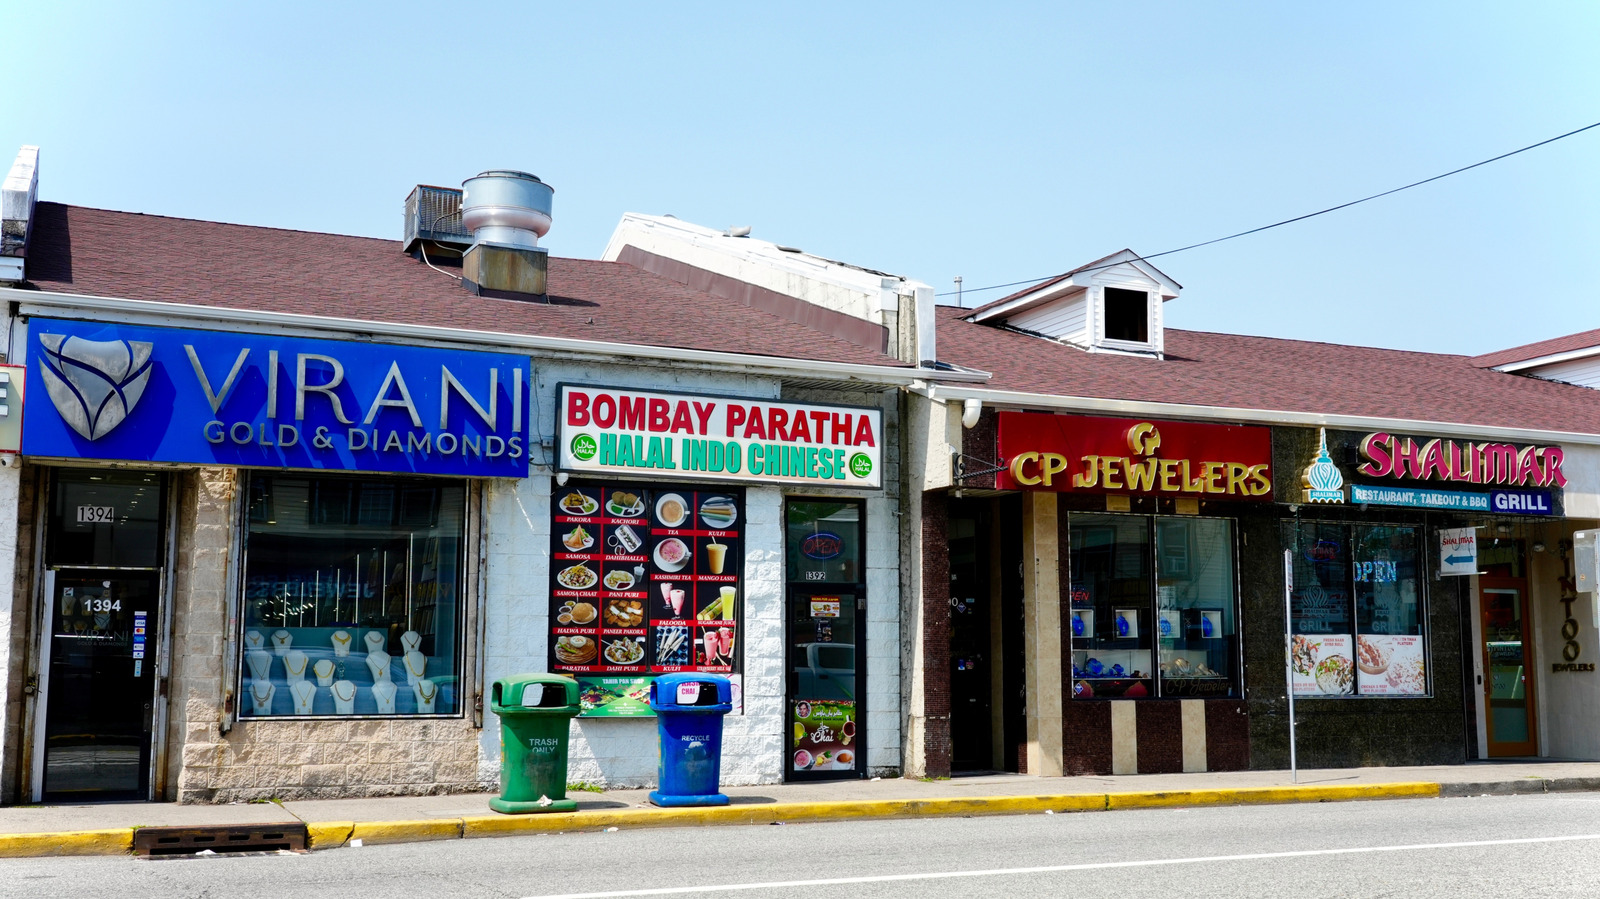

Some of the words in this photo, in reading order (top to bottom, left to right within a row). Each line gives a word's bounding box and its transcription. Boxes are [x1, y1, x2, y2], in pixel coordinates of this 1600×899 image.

[183, 343, 523, 432] VIRANI
[567, 391, 716, 435] BOMBAY
[726, 403, 876, 447] PARATHA
[203, 420, 299, 447] GOLD
[312, 426, 334, 449] &
[348, 428, 523, 459] DIAMONDS
[599, 432, 676, 469] HALAL
[681, 437, 742, 474] INDO
[748, 443, 846, 480] CHINESE
[1357, 432, 1569, 488] SHALIMAR
[1010, 451, 1068, 487] CP
[1073, 455, 1271, 496] JEWELERS
[1355, 488, 1417, 504] RESTAURANT,
[1420, 492, 1461, 506] TAKEOUT
[1462, 496, 1469, 507] &
[1470, 496, 1488, 508] BBQ
[1495, 493, 1548, 511] GRILL
[79, 506, 114, 522] 1394
[803, 538, 841, 554] OPEN
[1442, 536, 1474, 546] SHALIMAR
[806, 572, 826, 580] 1392
[84, 599, 122, 612] 1394
[1300, 620, 1332, 632] GRILL
[74, 630, 129, 642] VIRANI
[1552, 663, 1595, 674] JEWELERS
[1165, 680, 1186, 694] CP
[1189, 678, 1234, 696] Jewelers
[529, 738, 558, 746] TRASH
[812, 729, 834, 744] Chai
